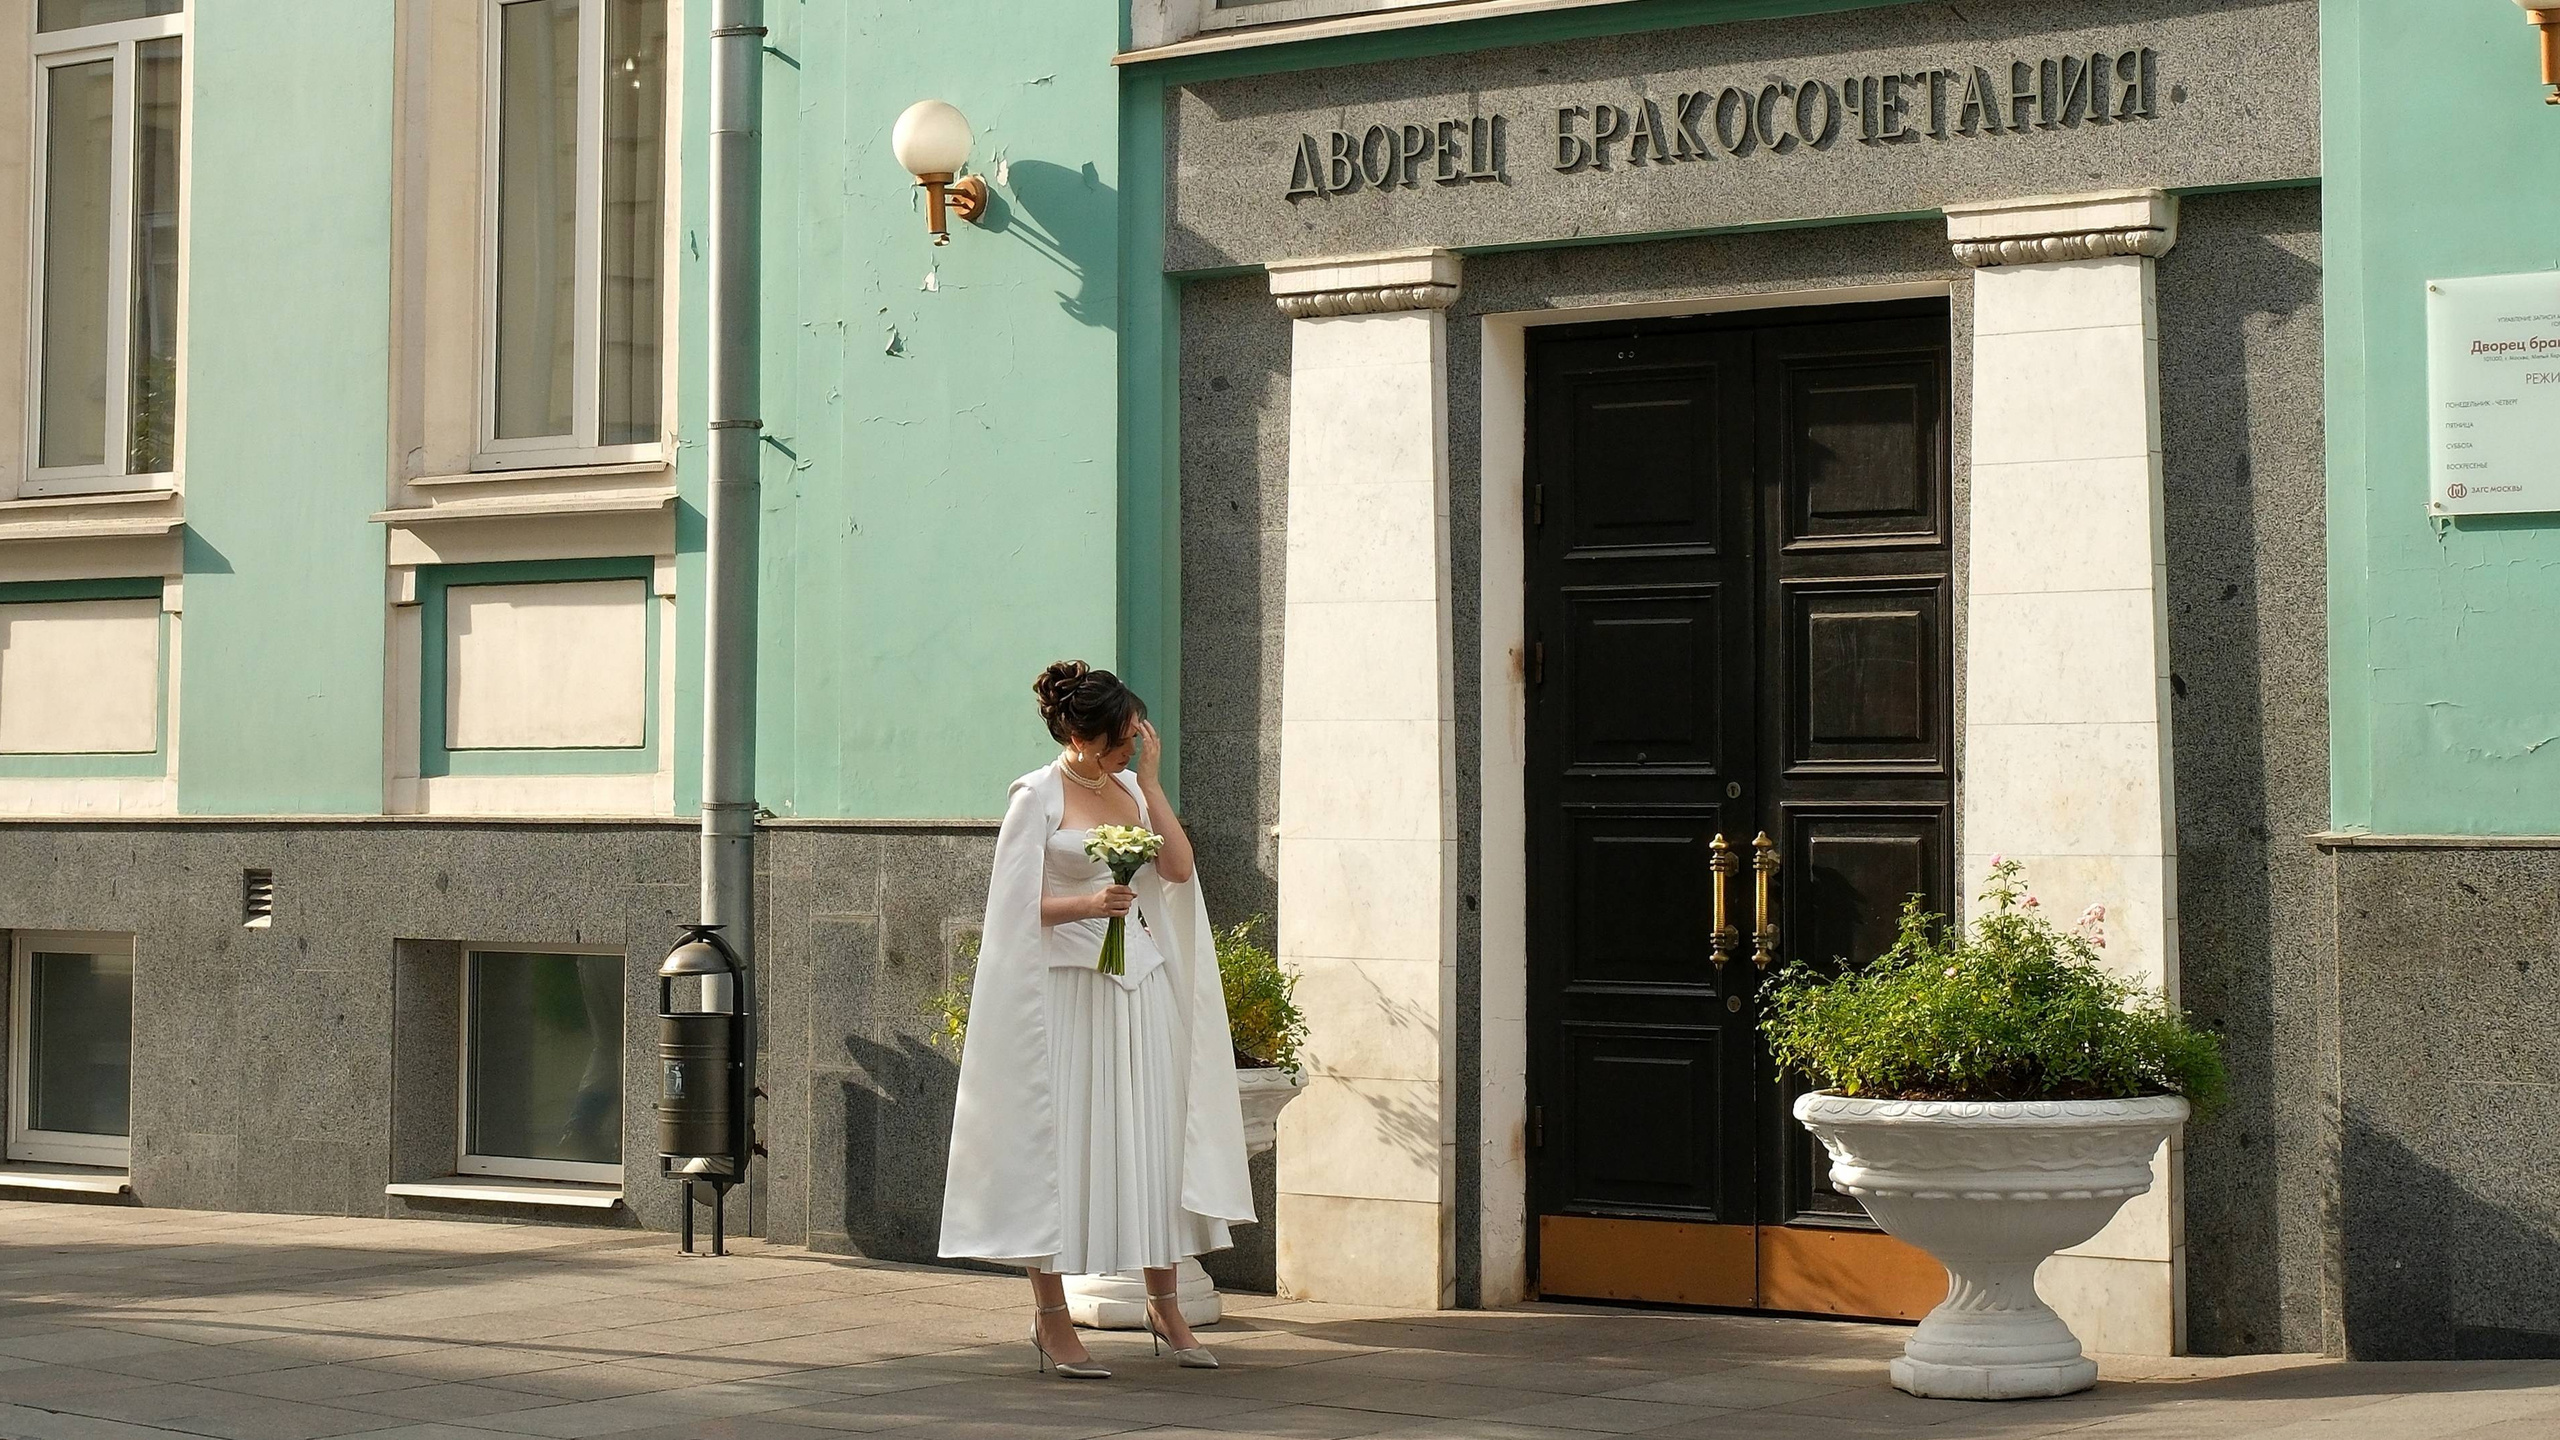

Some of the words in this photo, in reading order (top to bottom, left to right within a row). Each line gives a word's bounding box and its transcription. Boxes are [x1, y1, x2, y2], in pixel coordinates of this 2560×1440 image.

[1284, 113, 1501, 200] ДВОРЕЦ
[1553, 46, 2149, 170] БРАКОСОЧЕТАНИЯ
[2471, 340, 2526, 355] Дворец
[2529, 335, 2560, 353] бра
[2471, 486, 2489, 494] ЗАГС
[2490, 485, 2523, 493] МОСКВЫ
